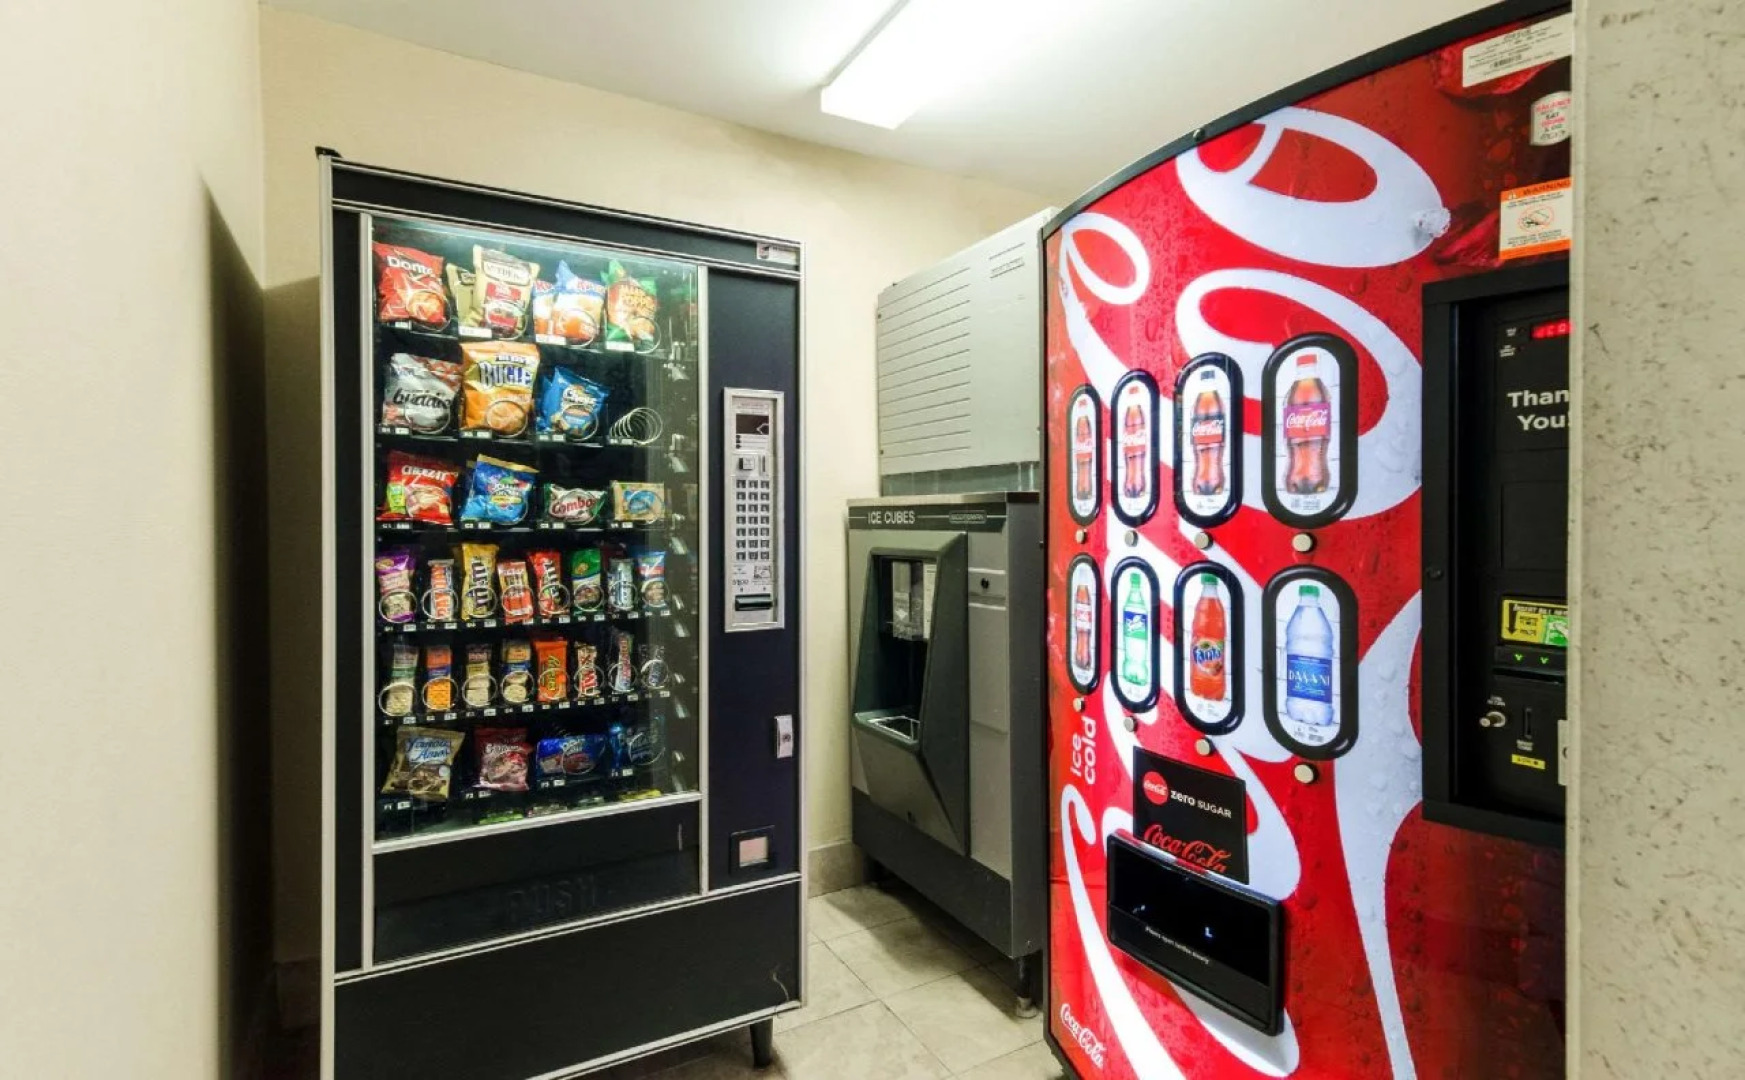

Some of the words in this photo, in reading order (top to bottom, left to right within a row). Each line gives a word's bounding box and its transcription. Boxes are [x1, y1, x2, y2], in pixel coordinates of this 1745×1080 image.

[478, 361, 532, 390] BUGLE
[1507, 390, 1569, 408] Than
[867, 512, 882, 525] ICE
[884, 510, 916, 525] CUBES
[1289, 670, 1330, 687] DASANI
[1070, 733, 1082, 777] ice
[1081, 715, 1097, 785] cold
[1170, 790, 1196, 807] zero
[1197, 800, 1232, 819] SUGAR
[1144, 824, 1231, 874] Coca-Cola
[505, 874, 598, 922] PUSH
[1061, 1003, 1107, 1068] Coca-Cola
